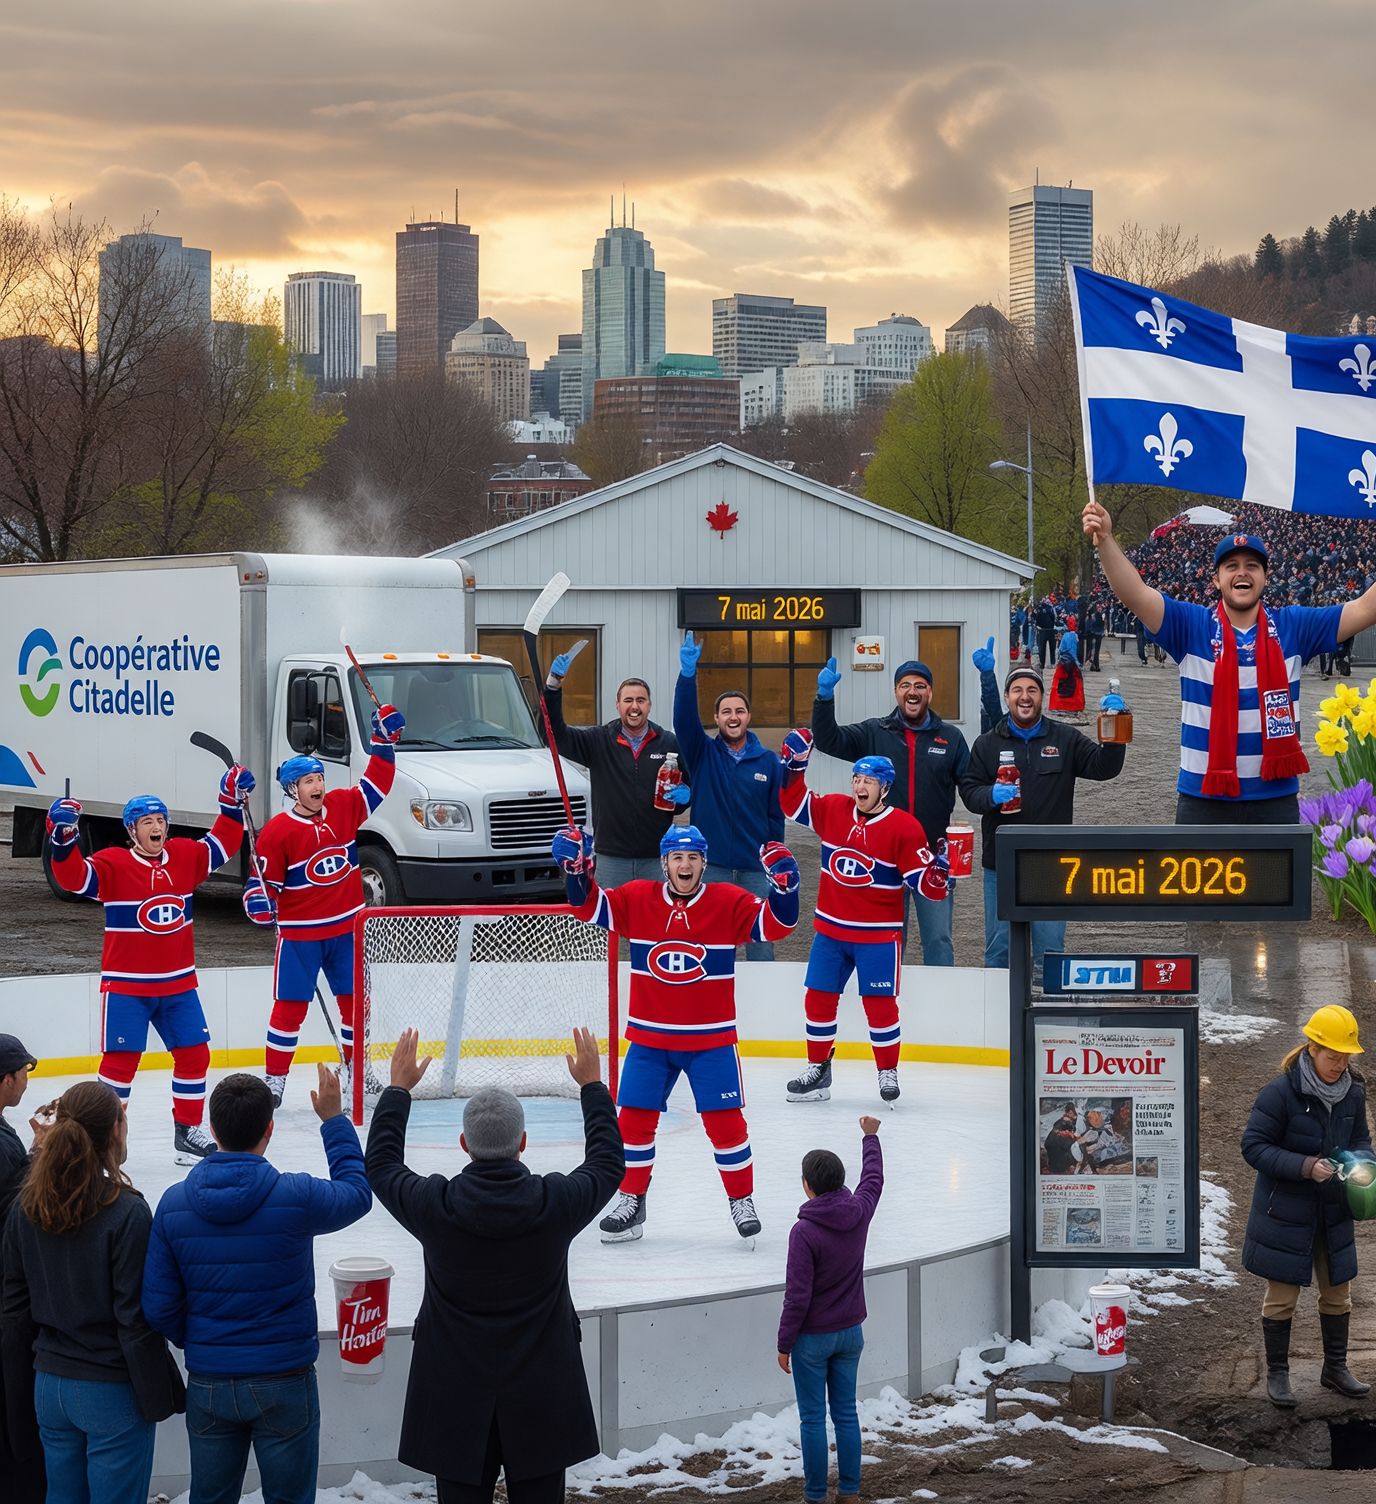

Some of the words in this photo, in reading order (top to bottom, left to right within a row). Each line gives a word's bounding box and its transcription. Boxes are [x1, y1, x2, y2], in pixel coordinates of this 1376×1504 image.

[718, 596, 731, 621] 7
[735, 596, 766, 621] mai
[773, 596, 824, 621] 2026
[69, 634, 221, 680] Coopérative
[69, 678, 175, 717] Citadelle
[1058, 856, 1081, 895] 7
[1091, 857, 1146, 896] mai
[1158, 855, 1248, 896] 2026
[1045, 1048, 1078, 1075] Le
[1081, 1048, 1166, 1075] Devoir
